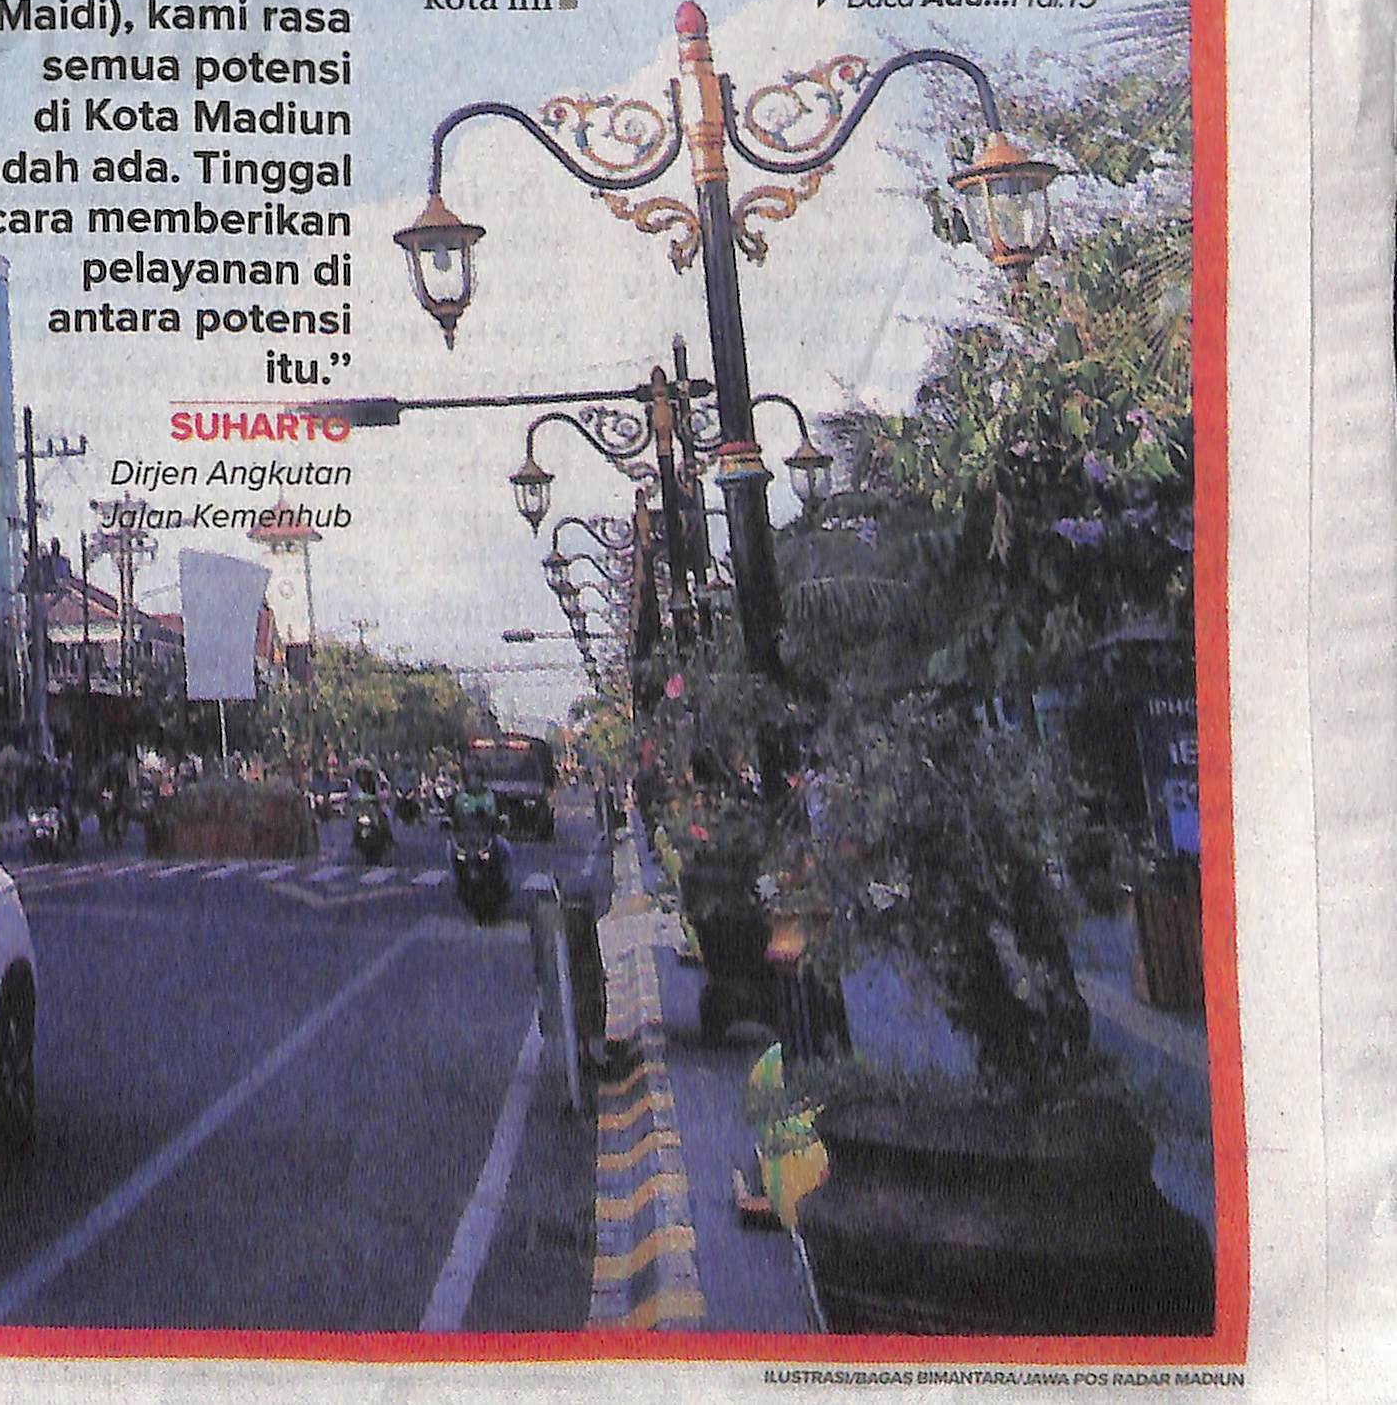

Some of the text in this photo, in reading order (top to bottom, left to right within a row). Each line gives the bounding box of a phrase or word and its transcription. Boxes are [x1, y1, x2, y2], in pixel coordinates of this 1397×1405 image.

[263, 7, 351, 33] rasa
[43, 50, 351, 90] semua potensi
[34, 97, 351, 136] di Kota Madiun
[92, 149, 180, 183] ada.
[193, 149, 351, 195] Tinggal
[88, 201, 350, 236] memberikan
[83, 250, 351, 292] pelayanan di
[48, 302, 351, 341] antara potensi
[169, 411, 352, 443] SUHARTO
[111, 460, 351, 492] Dirjen Angkutan
[100, 502, 353, 531] Jalan Kemenhub
[1072, 1370, 1109, 1388] POS
[1111, 1370, 1172, 1389] RADAR
[1174, 1370, 1246, 1389] MADIUN
